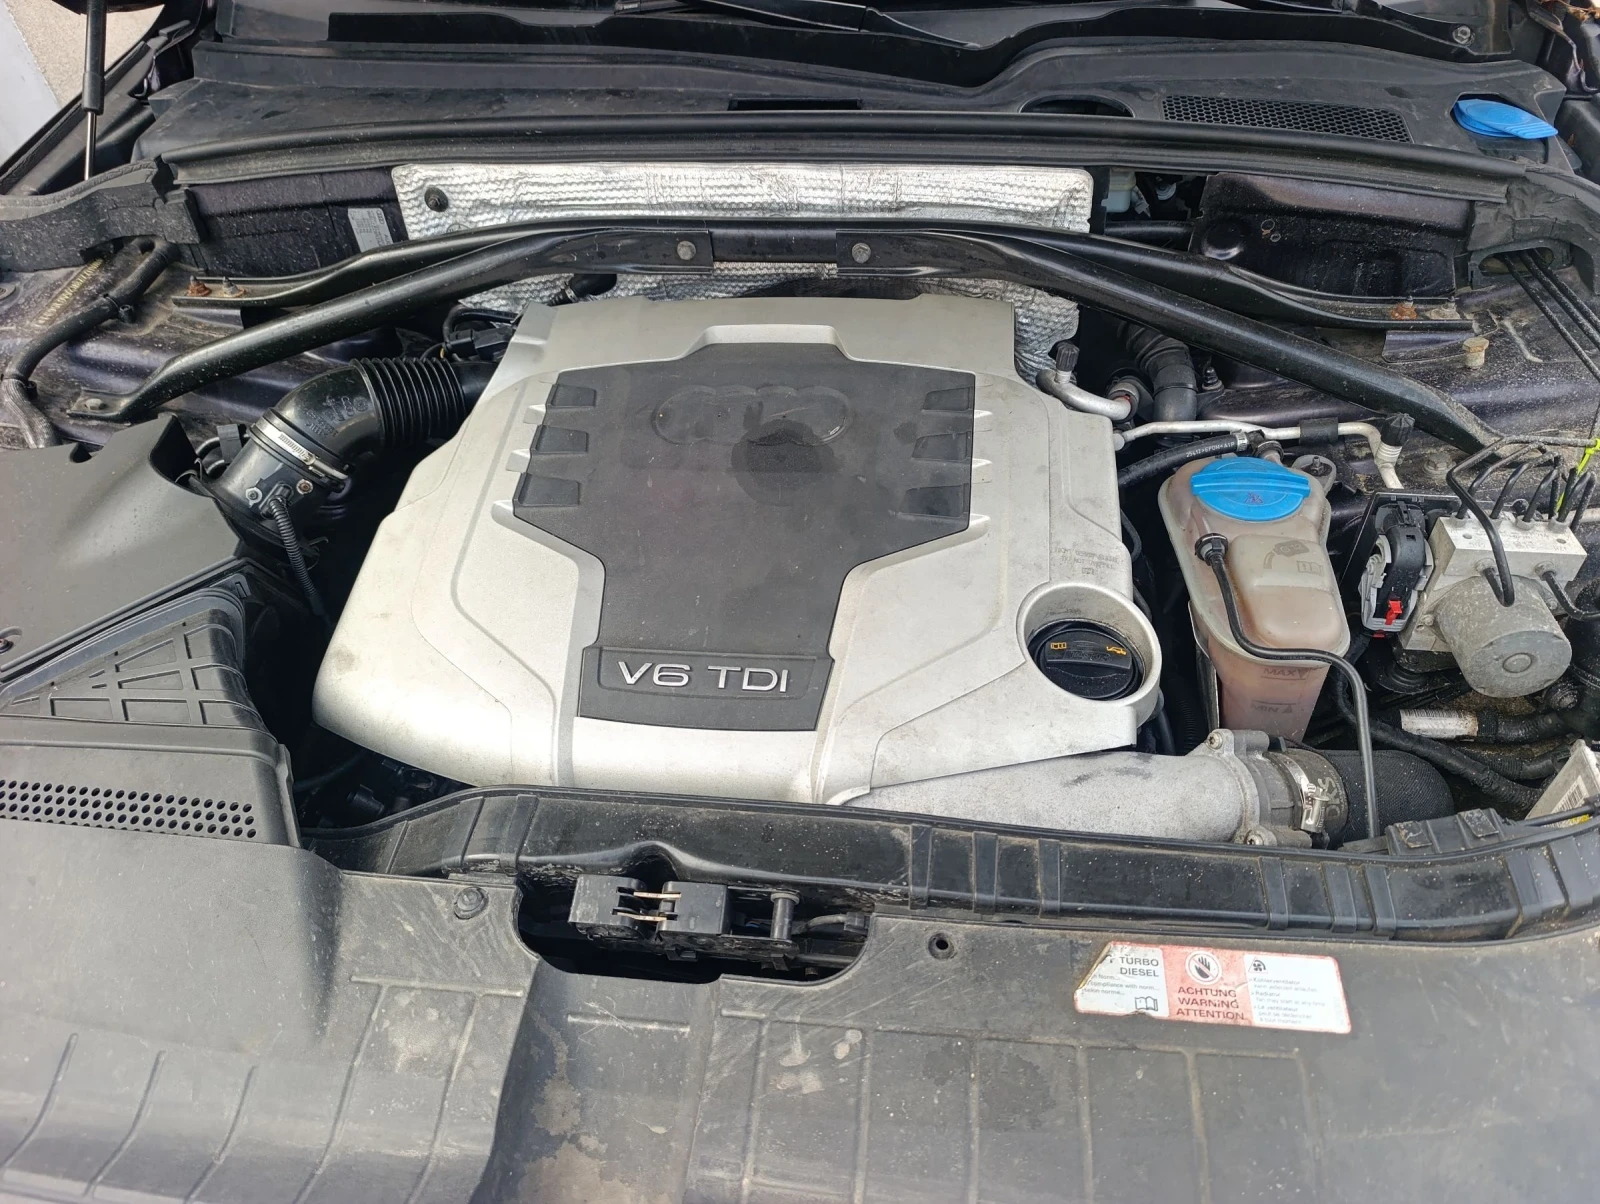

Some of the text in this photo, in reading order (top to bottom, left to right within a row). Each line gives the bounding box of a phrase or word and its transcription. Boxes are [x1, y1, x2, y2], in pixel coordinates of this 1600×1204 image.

[618, 661, 789, 692] V6 TDI
[1263, 667, 1297, 676] MAX
[1251, 703, 1279, 713] MIN
[1119, 956, 1159, 967] TURBO
[1120, 967, 1159, 977] DIESEL
[1177, 986, 1237, 997] ACHTUNG
[1177, 997, 1239, 1009] WARNING
[1176, 1008, 1245, 1020] ATTENTION
